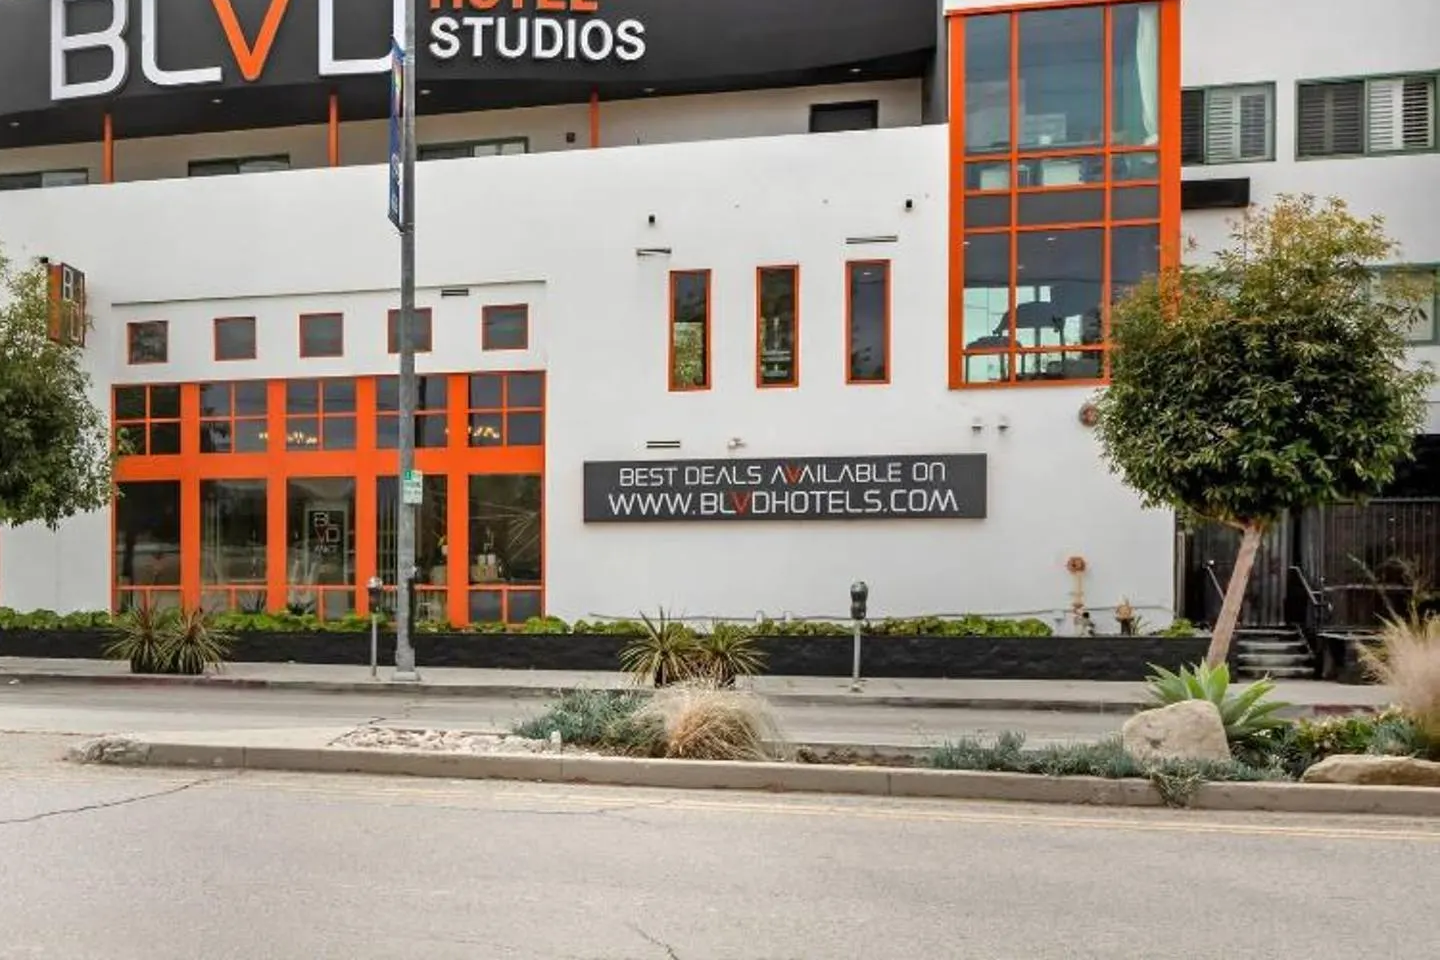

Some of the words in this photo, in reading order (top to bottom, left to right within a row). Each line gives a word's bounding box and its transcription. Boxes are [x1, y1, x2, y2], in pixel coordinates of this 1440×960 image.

[429, 17, 646, 61] STUDIOS
[619, 467, 679, 487] BEST
[685, 465, 762, 485] DEALS
[770, 462, 903, 485] AVAILABLE
[608, 489, 959, 516] WWW.BLVDHOTELS.COM
